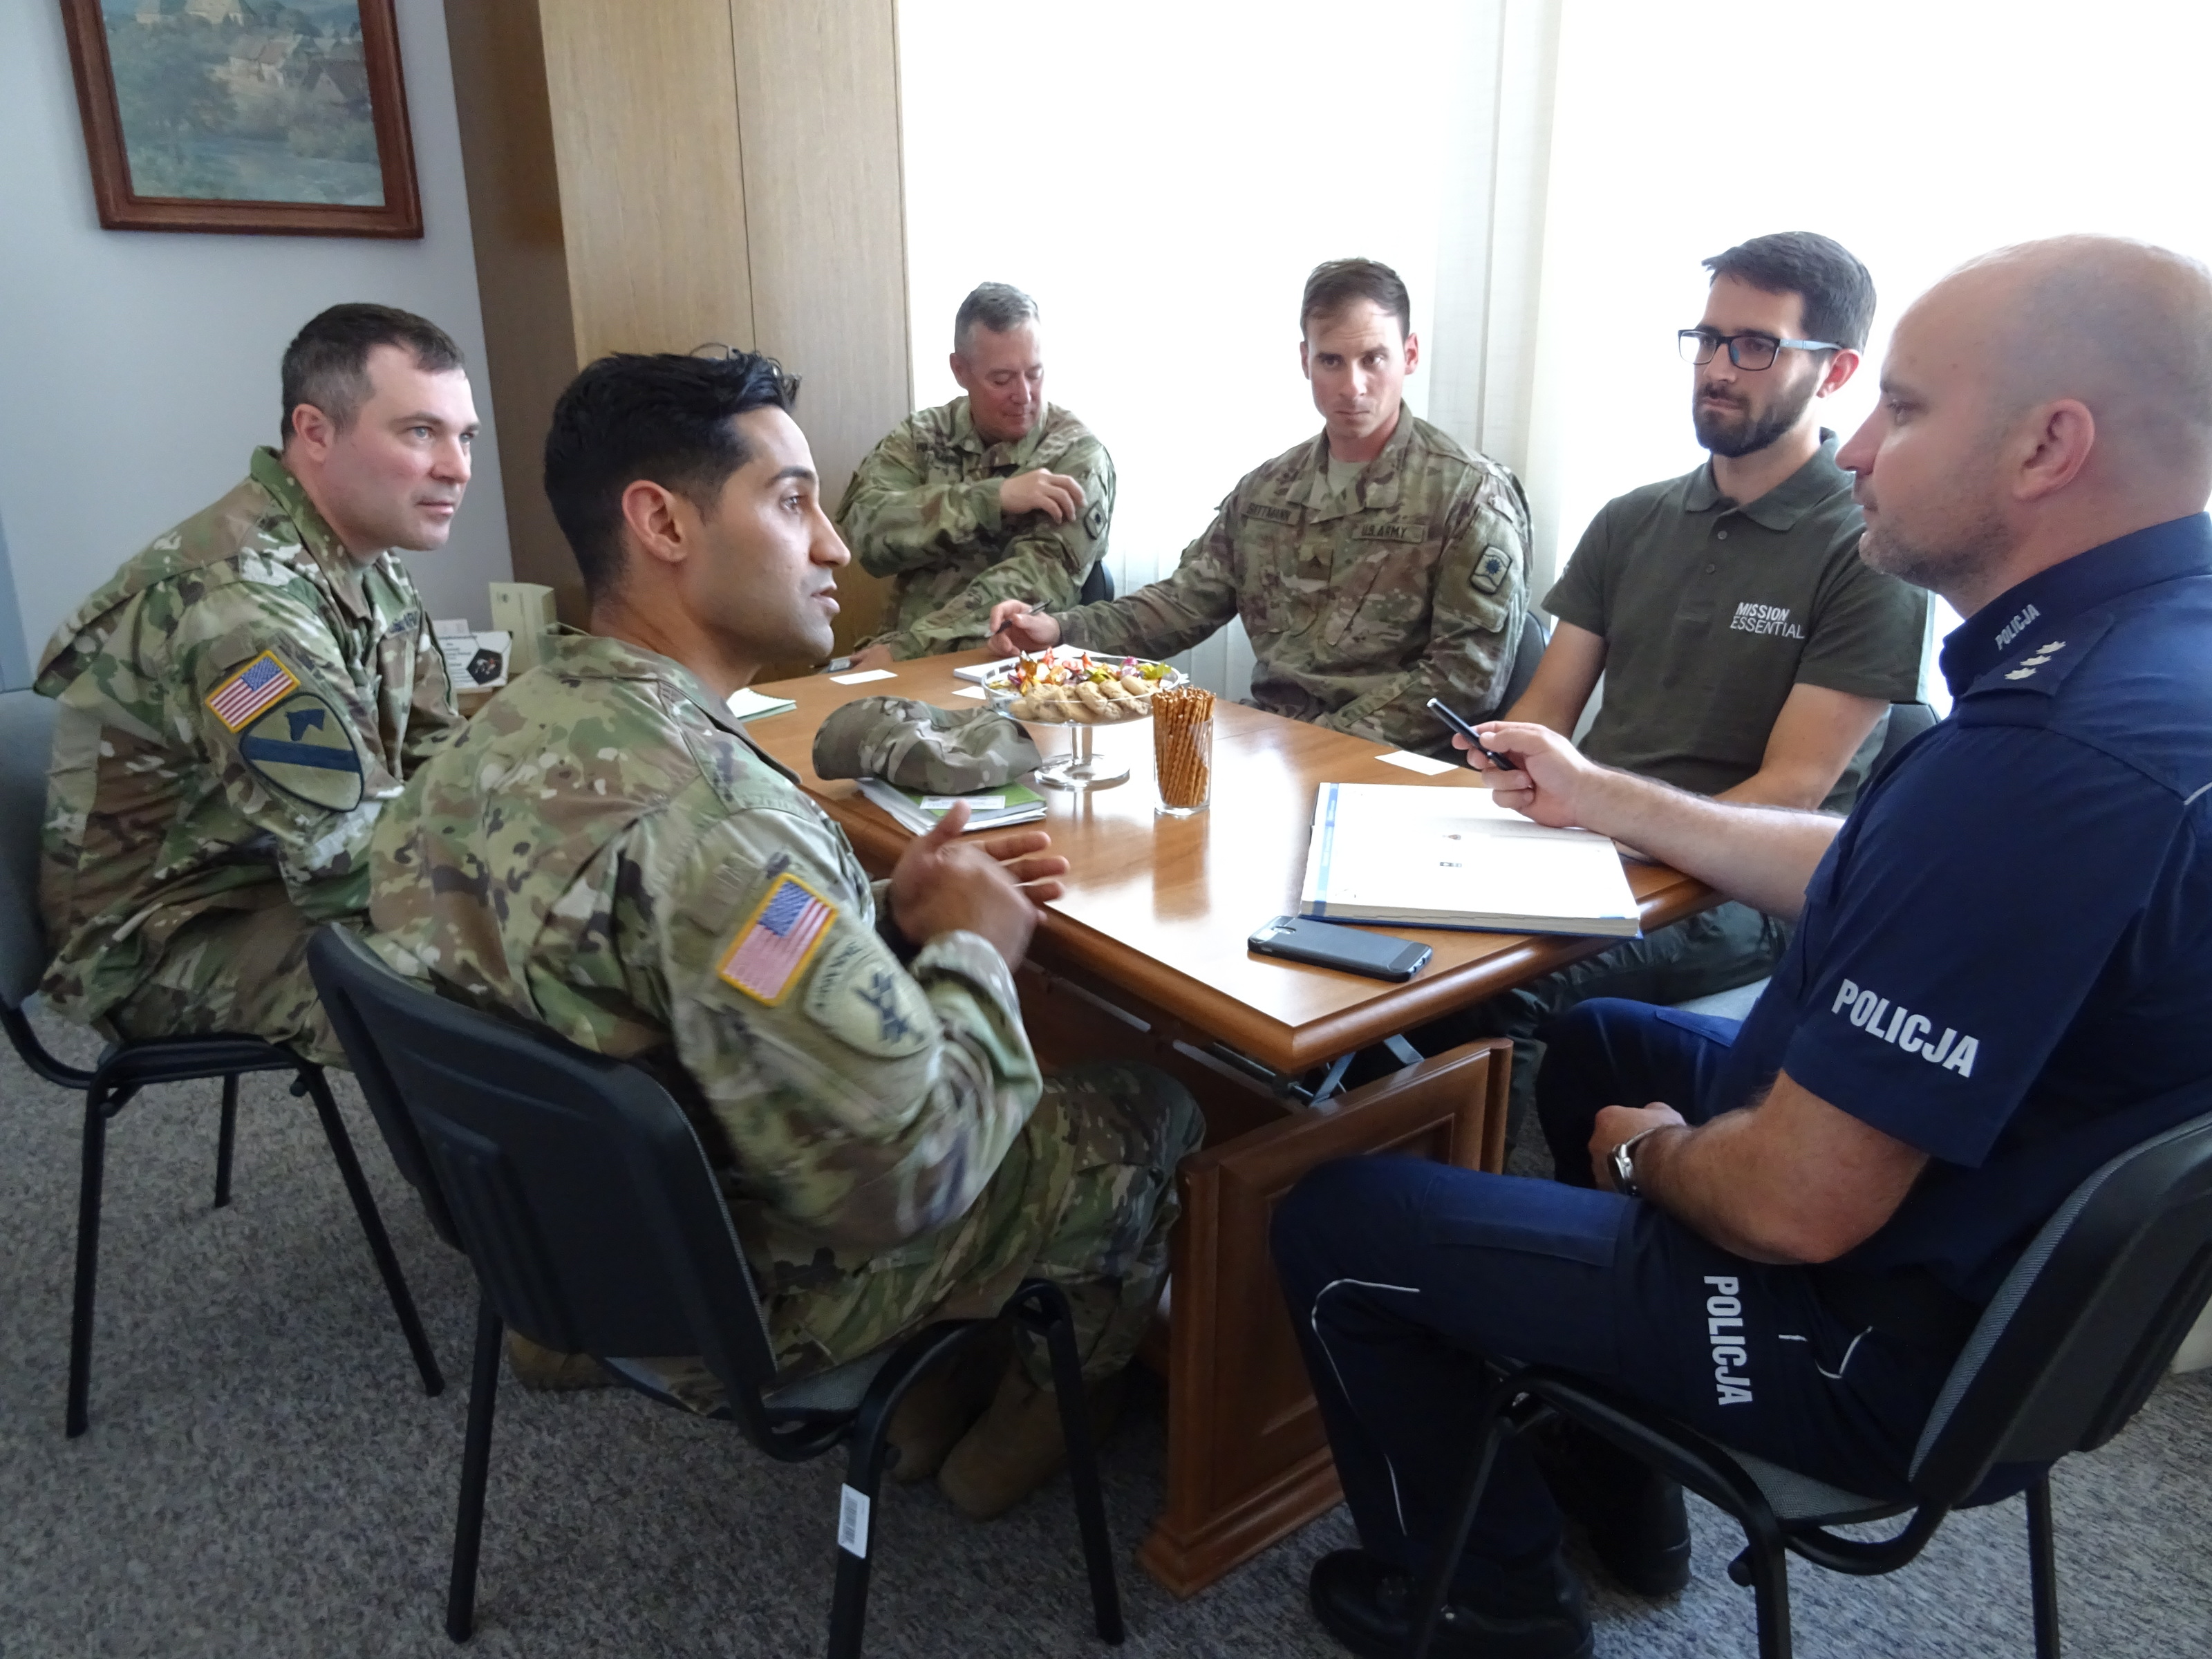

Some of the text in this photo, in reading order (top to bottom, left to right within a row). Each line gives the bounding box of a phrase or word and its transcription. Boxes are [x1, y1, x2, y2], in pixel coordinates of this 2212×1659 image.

[1377, 525, 1407, 538] ARMY
[1730, 615, 1805, 639] ESSENTIAL
[1735, 602, 1790, 621] MISSION
[1995, 604, 2041, 650] POLICJA
[1832, 979, 1980, 1078] POLICJA
[1704, 1276, 1753, 1405] POLICJA
